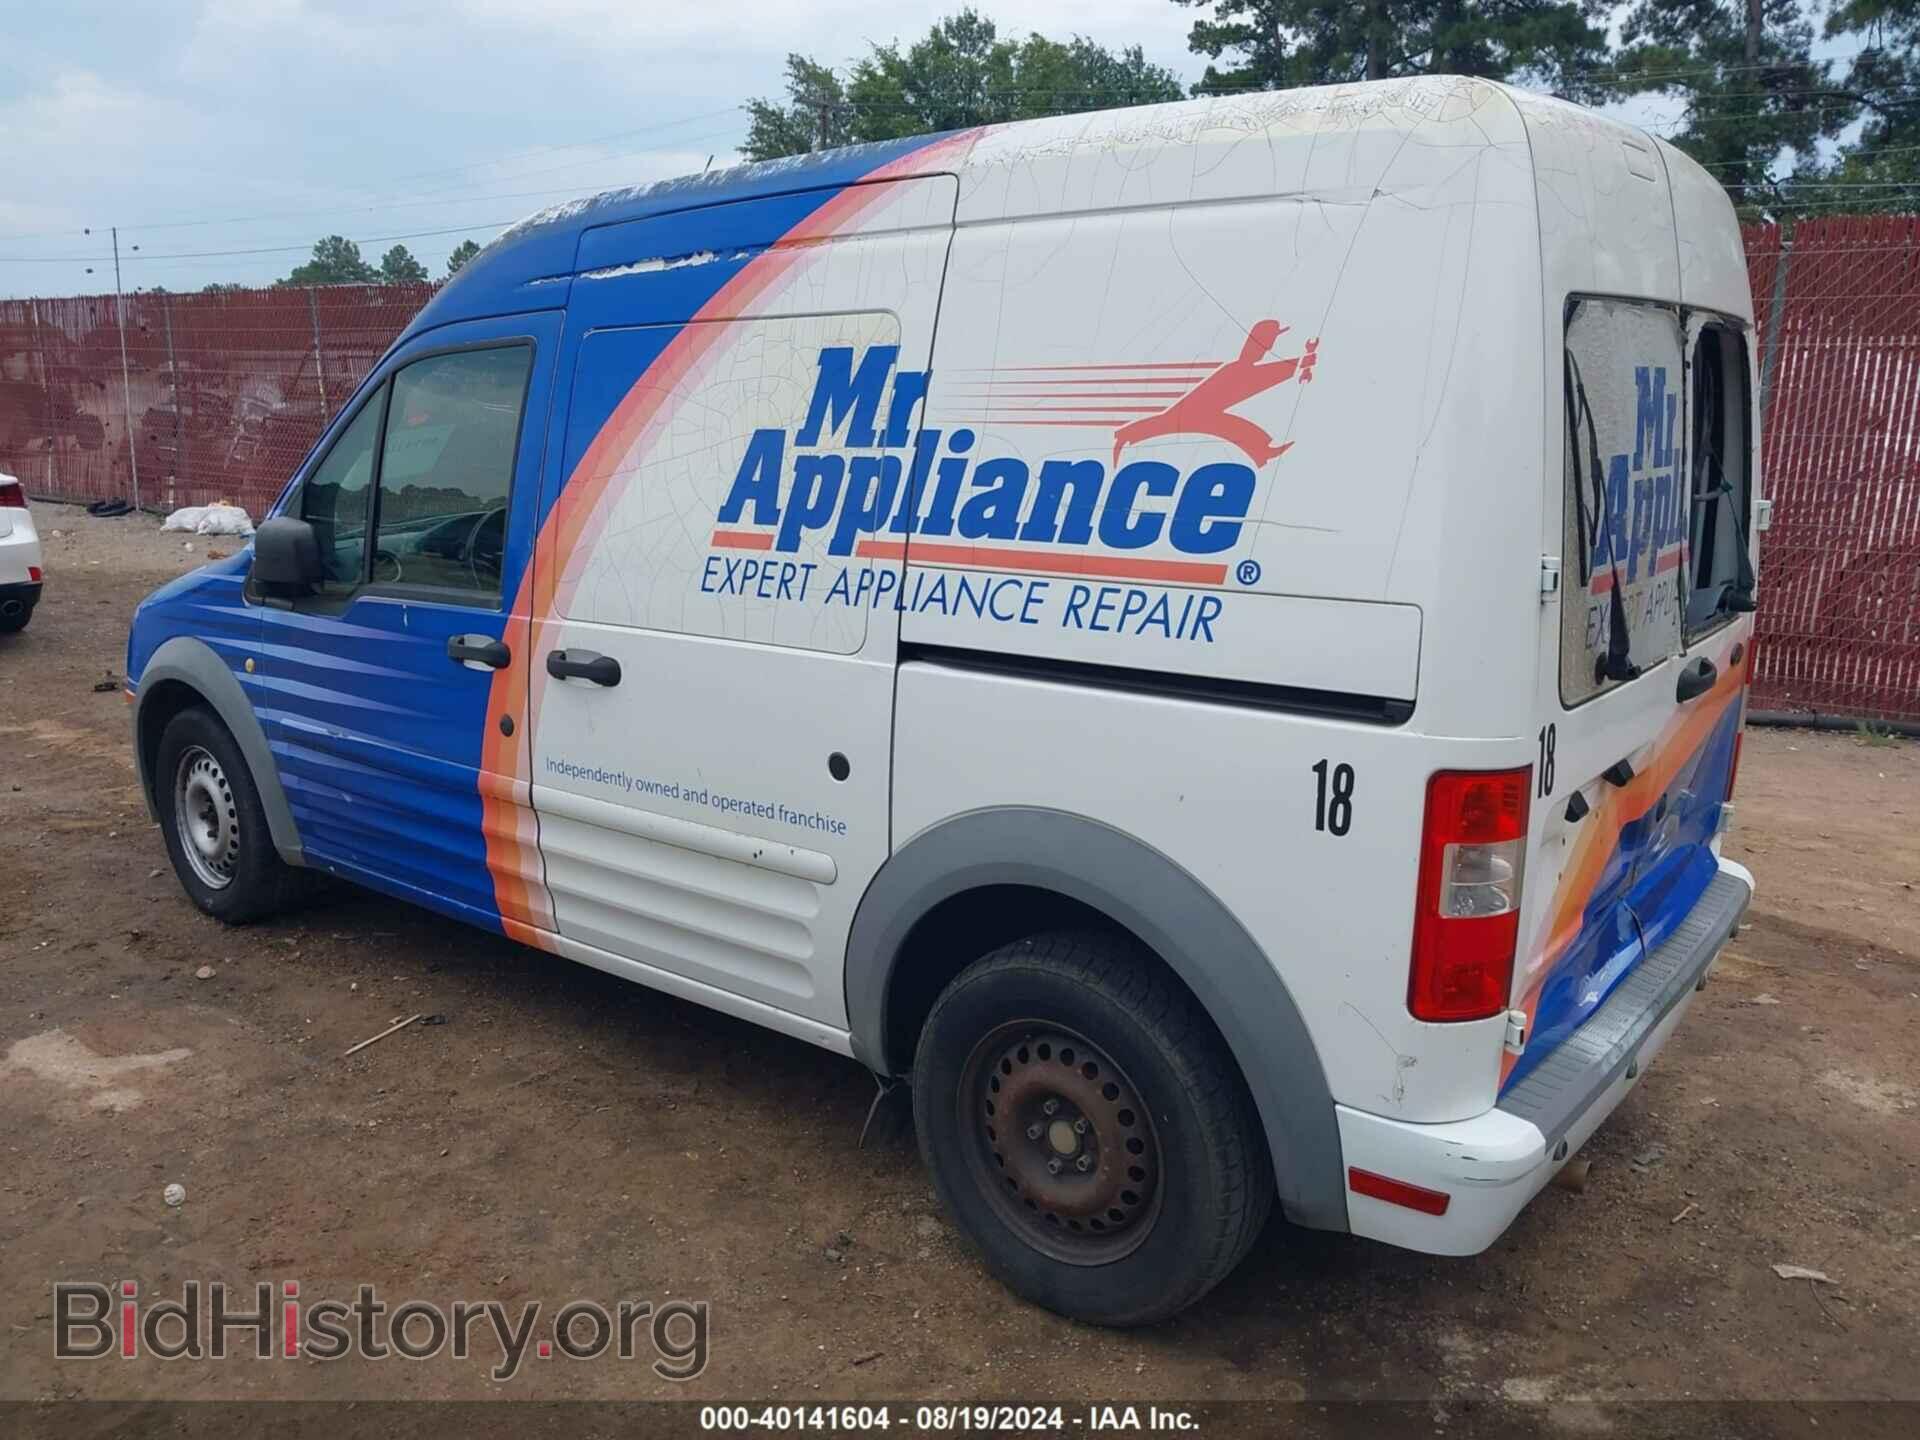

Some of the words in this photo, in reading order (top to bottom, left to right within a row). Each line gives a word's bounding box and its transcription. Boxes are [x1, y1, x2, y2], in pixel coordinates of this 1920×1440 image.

[795, 345, 933, 449] Mr
[717, 428, 1258, 555] Appliance
[700, 556, 817, 602] EXPERT
[825, 566, 1050, 625] APPLIANCE
[1062, 585, 1223, 642] REPAIR
[546, 757, 633, 792] Independently
[636, 776, 679, 799] owned
[683, 787, 708, 805] and
[711, 793, 775, 819] operated
[778, 804, 847, 836] franchise
[1312, 759, 1355, 837] 18
[1537, 723, 1557, 799] 18
